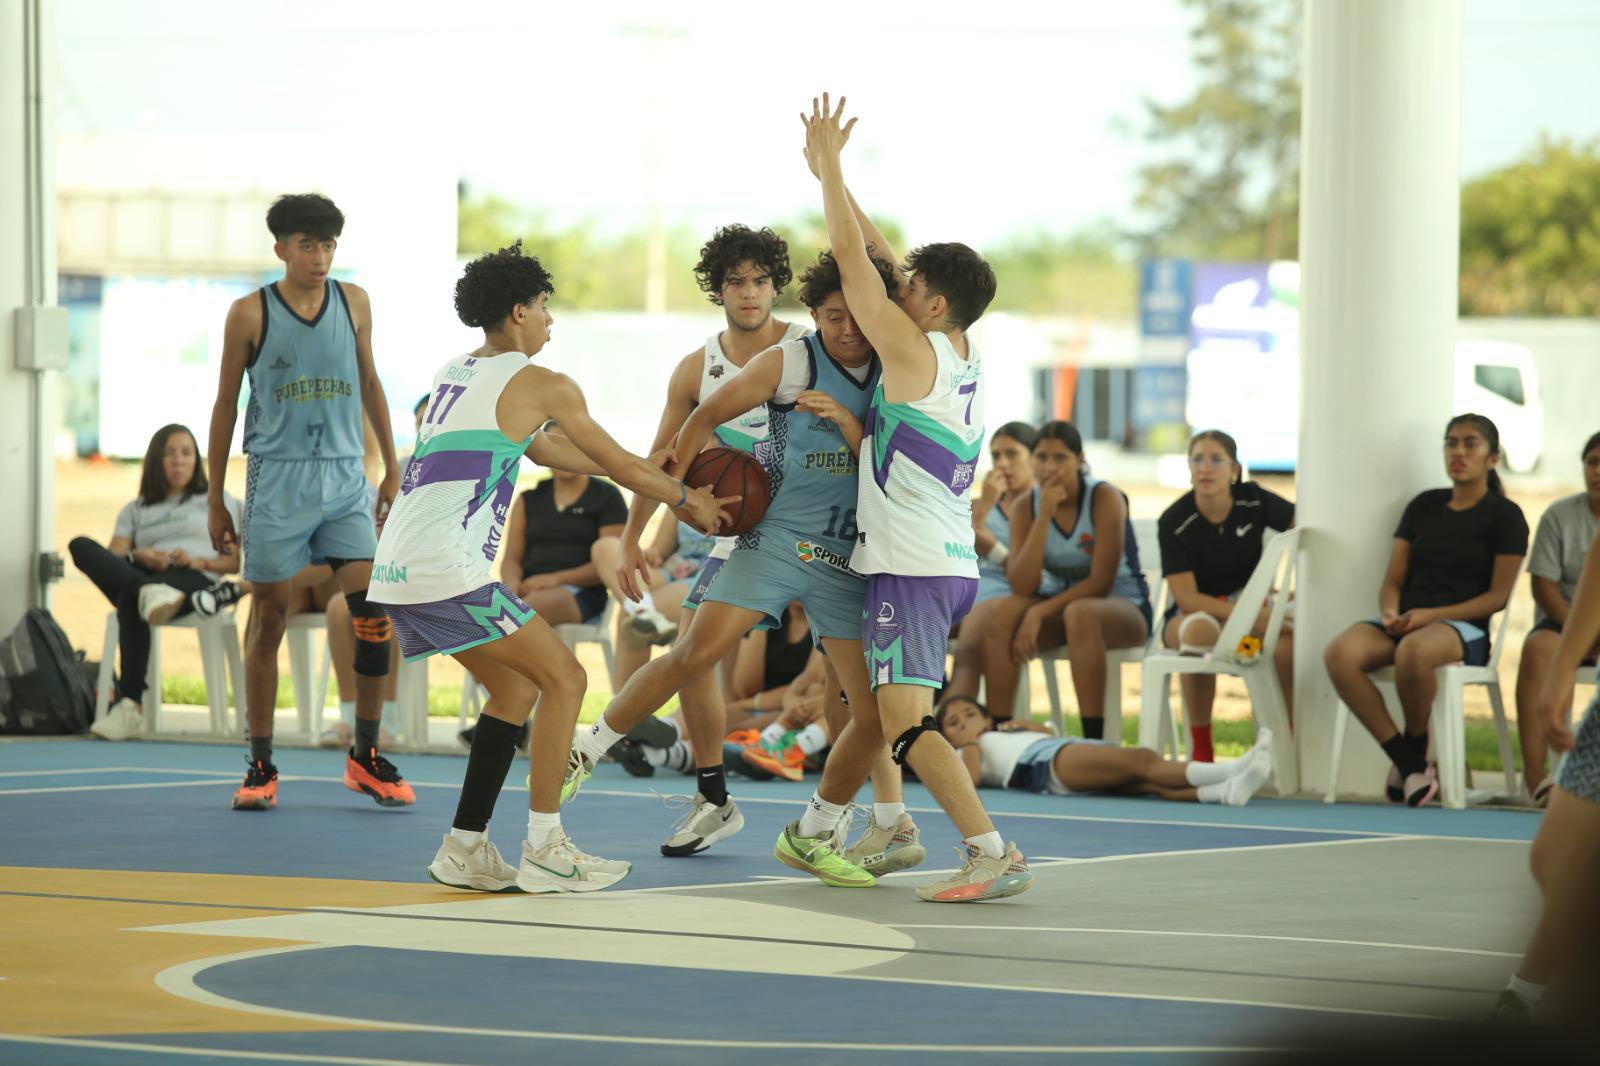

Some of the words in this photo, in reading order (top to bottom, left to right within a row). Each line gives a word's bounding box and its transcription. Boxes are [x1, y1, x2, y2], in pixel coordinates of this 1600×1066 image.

[445, 366, 478, 383] RUDY
[426, 383, 467, 425] 17
[958, 381, 977, 426] 7
[307, 423, 325, 448] 7
